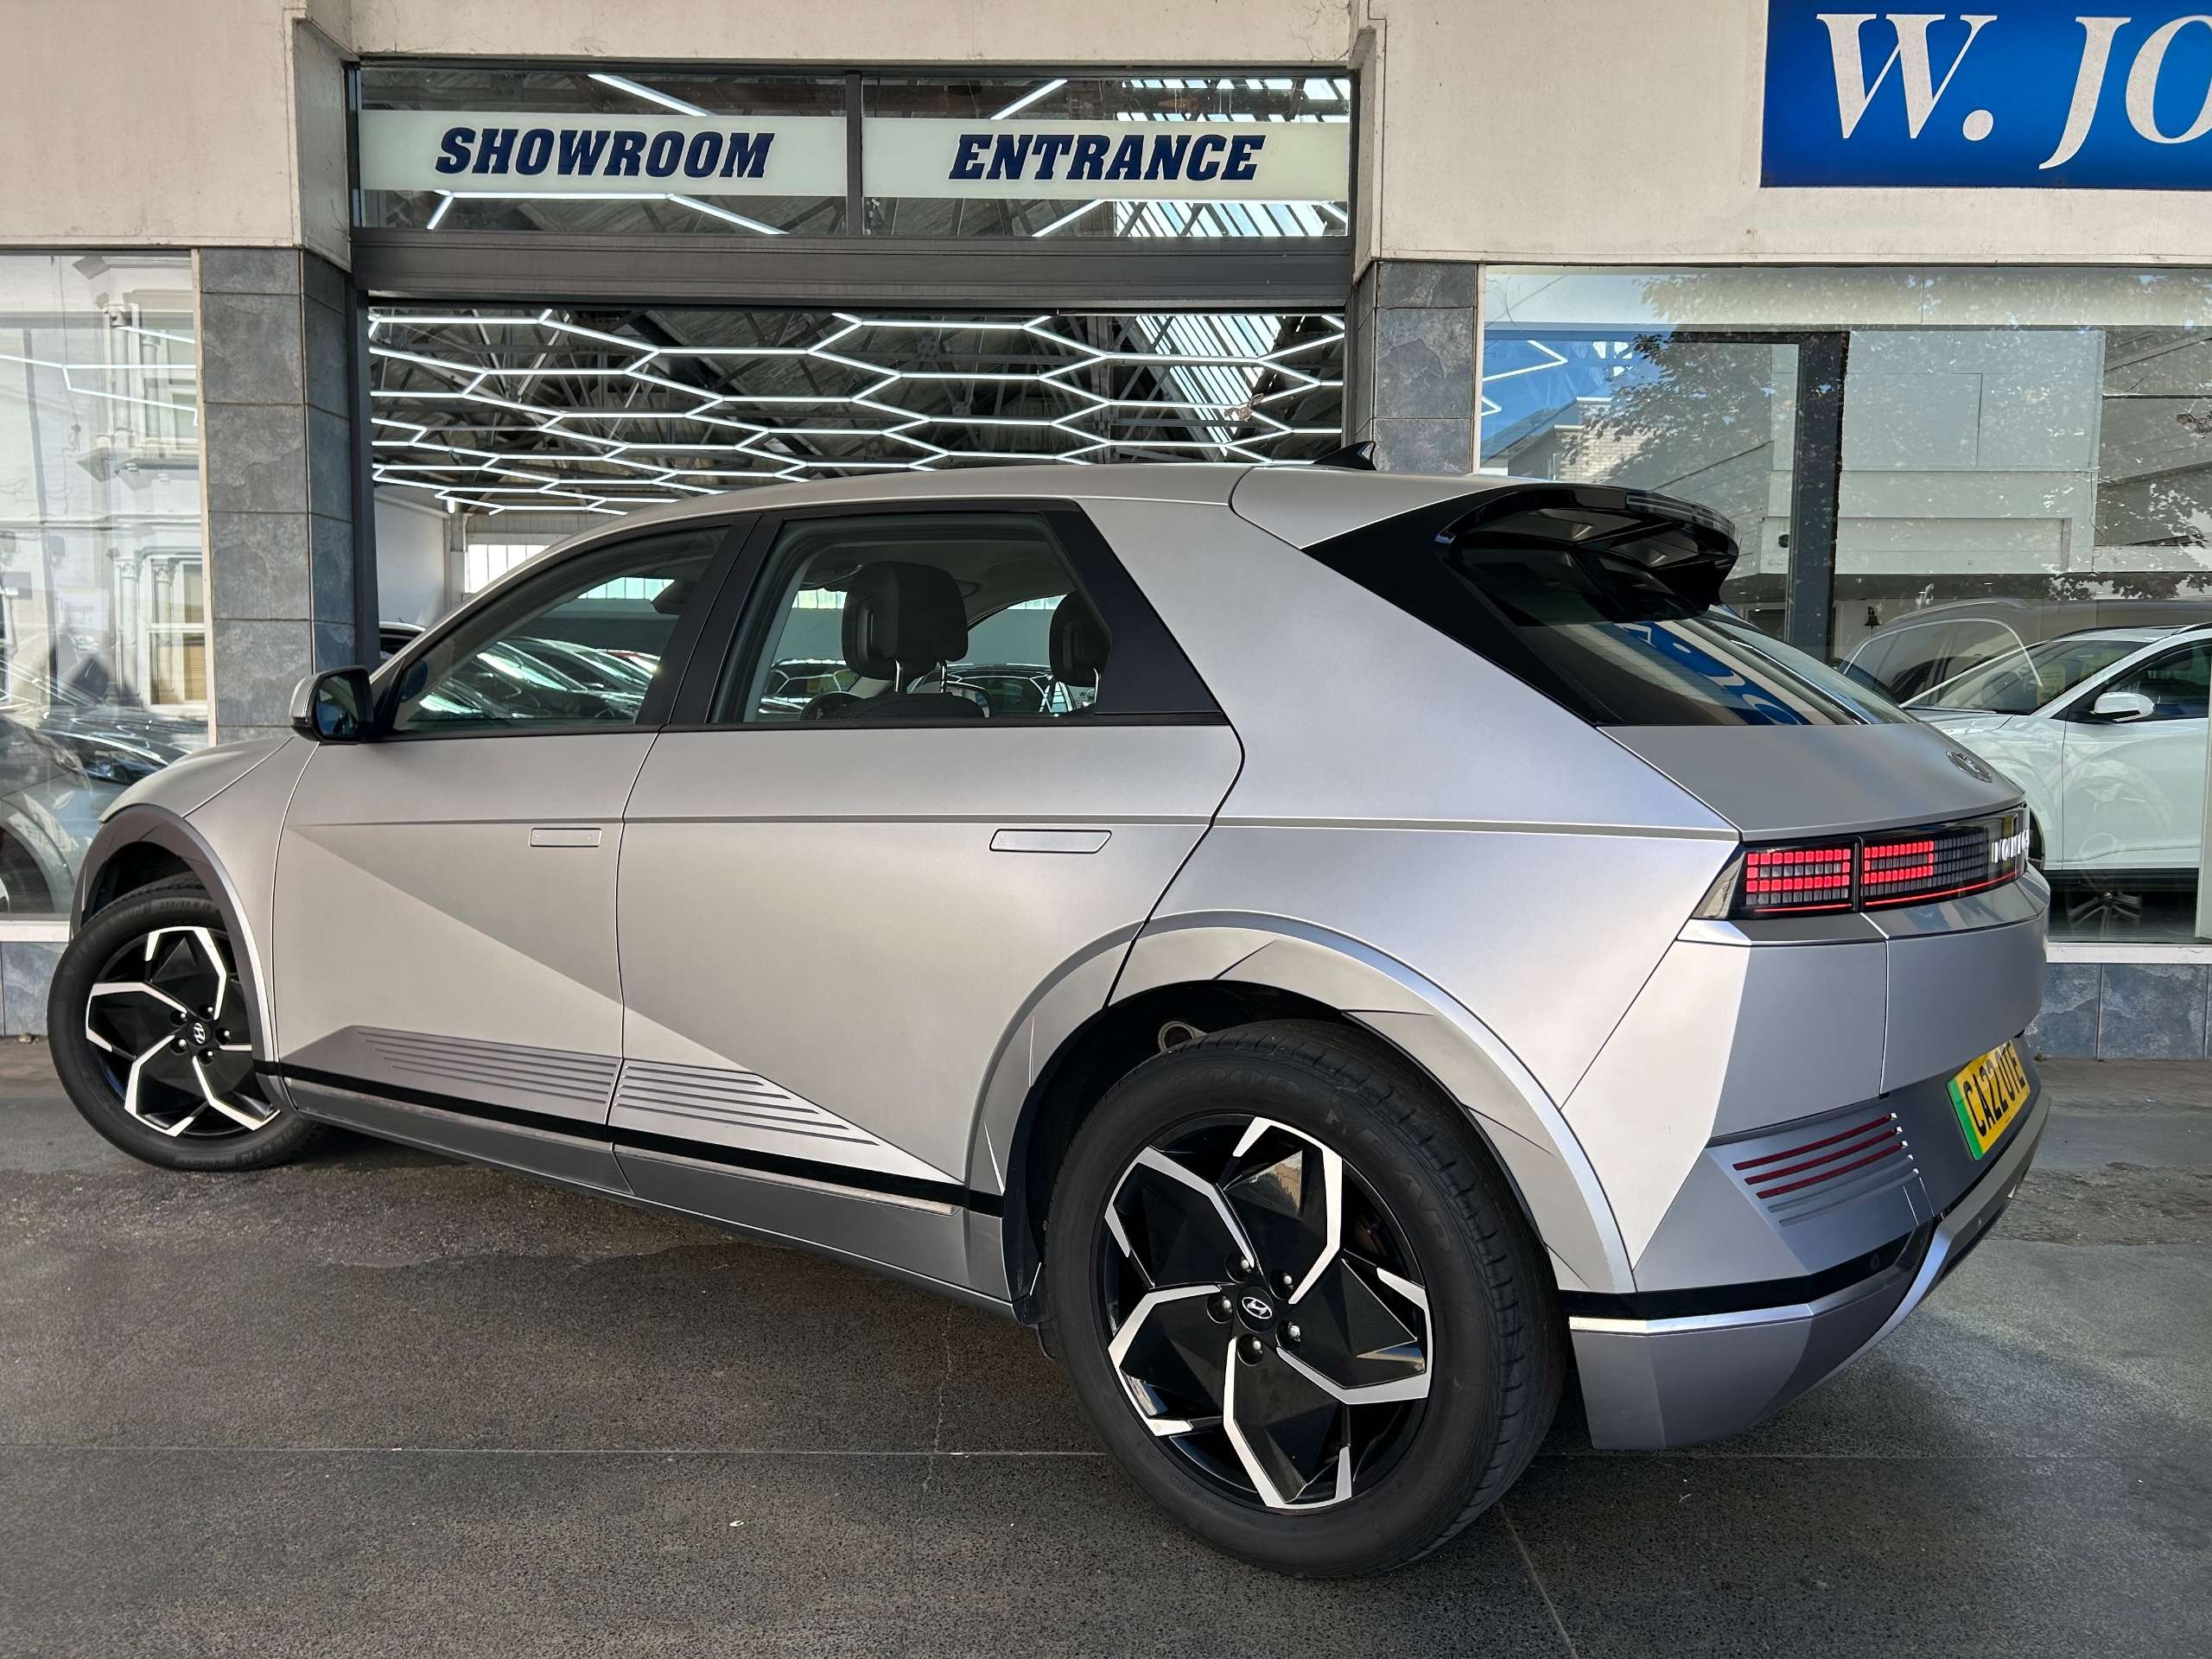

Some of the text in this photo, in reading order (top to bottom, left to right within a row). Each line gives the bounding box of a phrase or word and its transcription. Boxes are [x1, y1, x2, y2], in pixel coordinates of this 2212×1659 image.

[1815, 13, 2212, 170] W. JO
[435, 127, 1267, 181] SHOWROOM ENTRANCE
[1962, 1057, 2010, 1137] CA22
